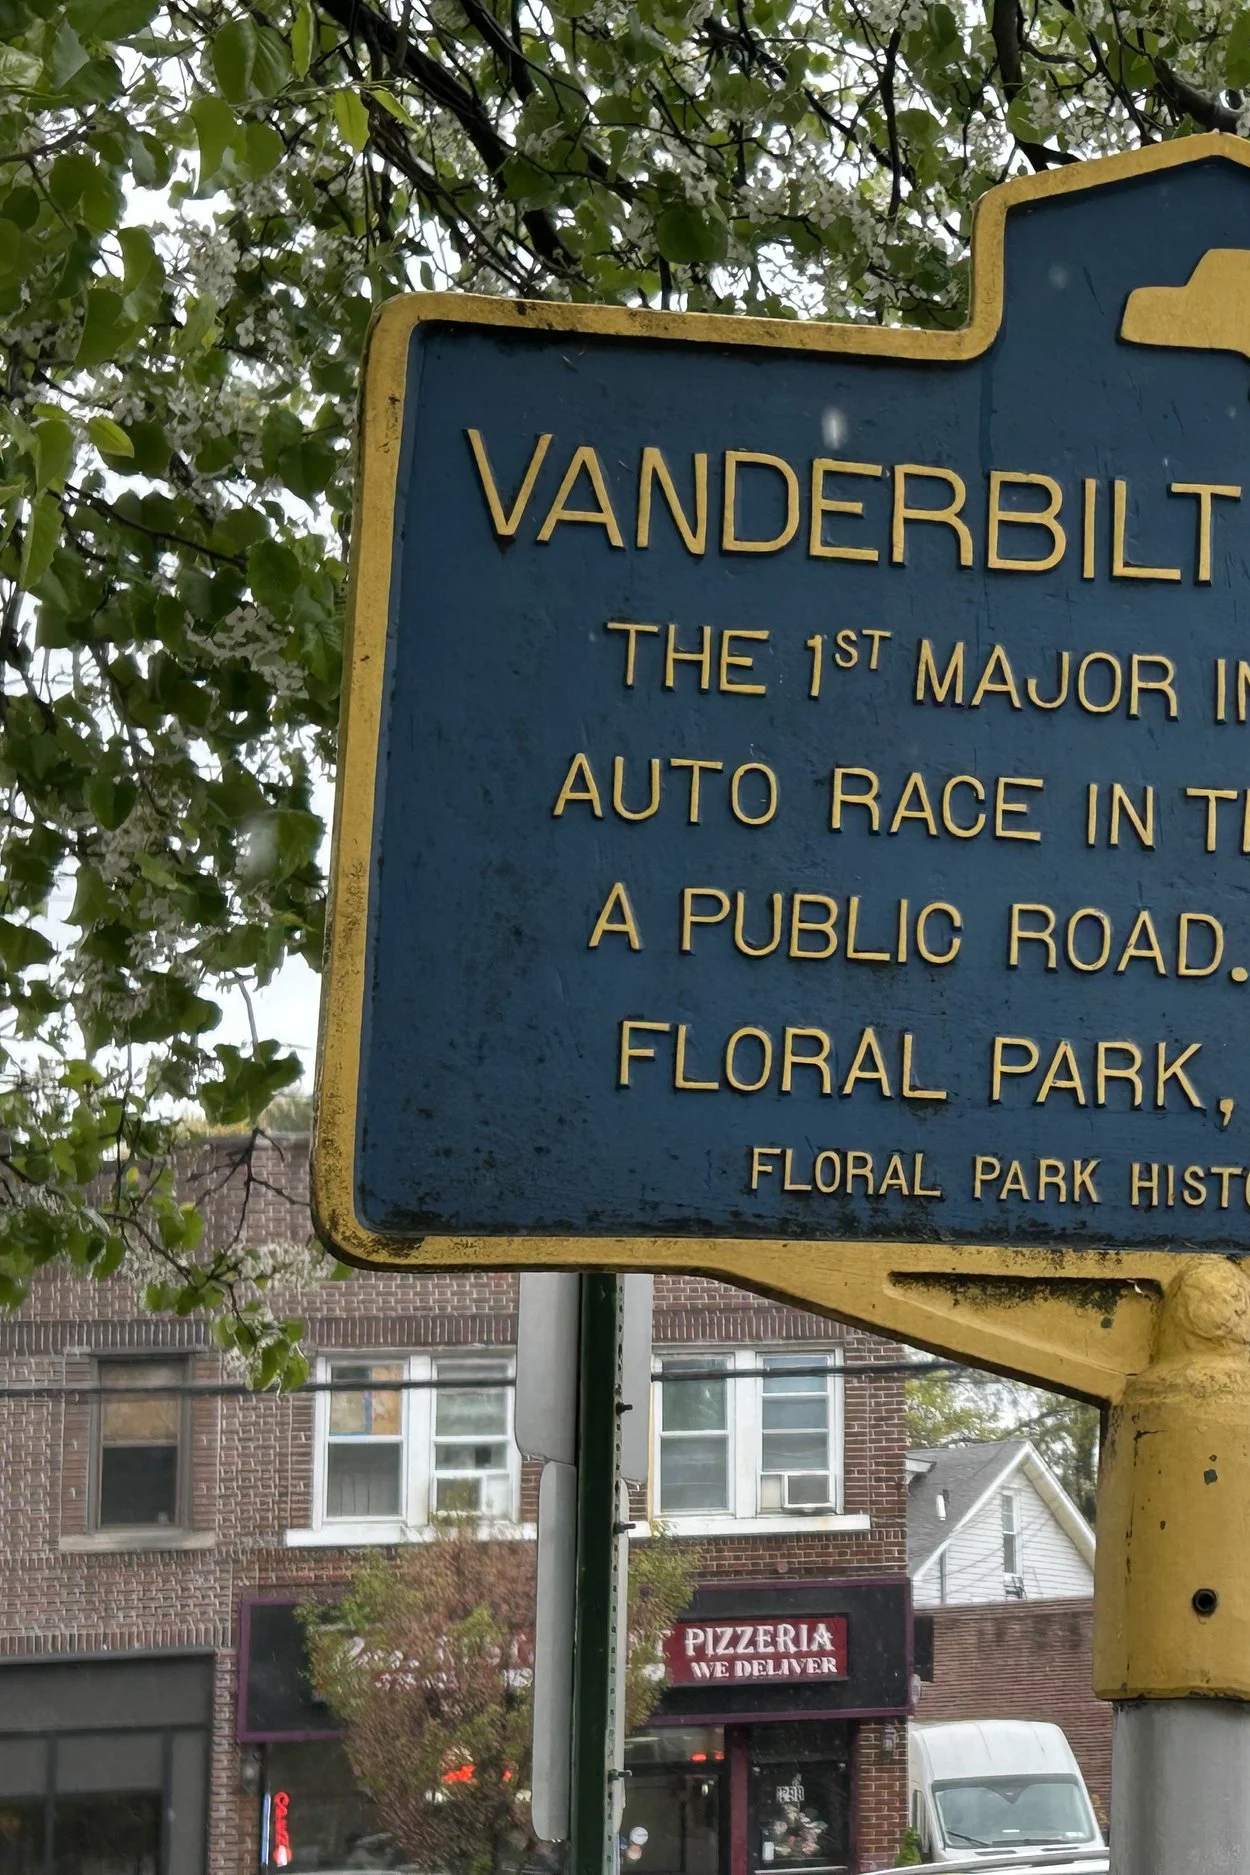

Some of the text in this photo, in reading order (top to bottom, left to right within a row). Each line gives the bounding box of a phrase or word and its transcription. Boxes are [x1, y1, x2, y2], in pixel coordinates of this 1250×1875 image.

[468, 429, 1241, 583] VANDERBILT
[608, 623, 768, 693] THE
[917, 640, 1177, 716] MAJOR
[554, 754, 777, 824] AUTO
[832, 768, 1043, 840] RACE
[1089, 784, 1153, 845] IN
[590, 882, 640, 949] A
[683, 888, 961, 963] PUBLIC
[1010, 904, 1248, 981] ROAD.
[621, 1021, 946, 1099] FLORAL
[993, 1037, 1233, 1124] PARK,
[752, 1148, 940, 1195] FLORAL
[975, 1157, 1097, 1202] PARK
[685, 1623, 834, 1657] PIZZERIA
[691, 1657, 837, 1678] WE DELIVER
